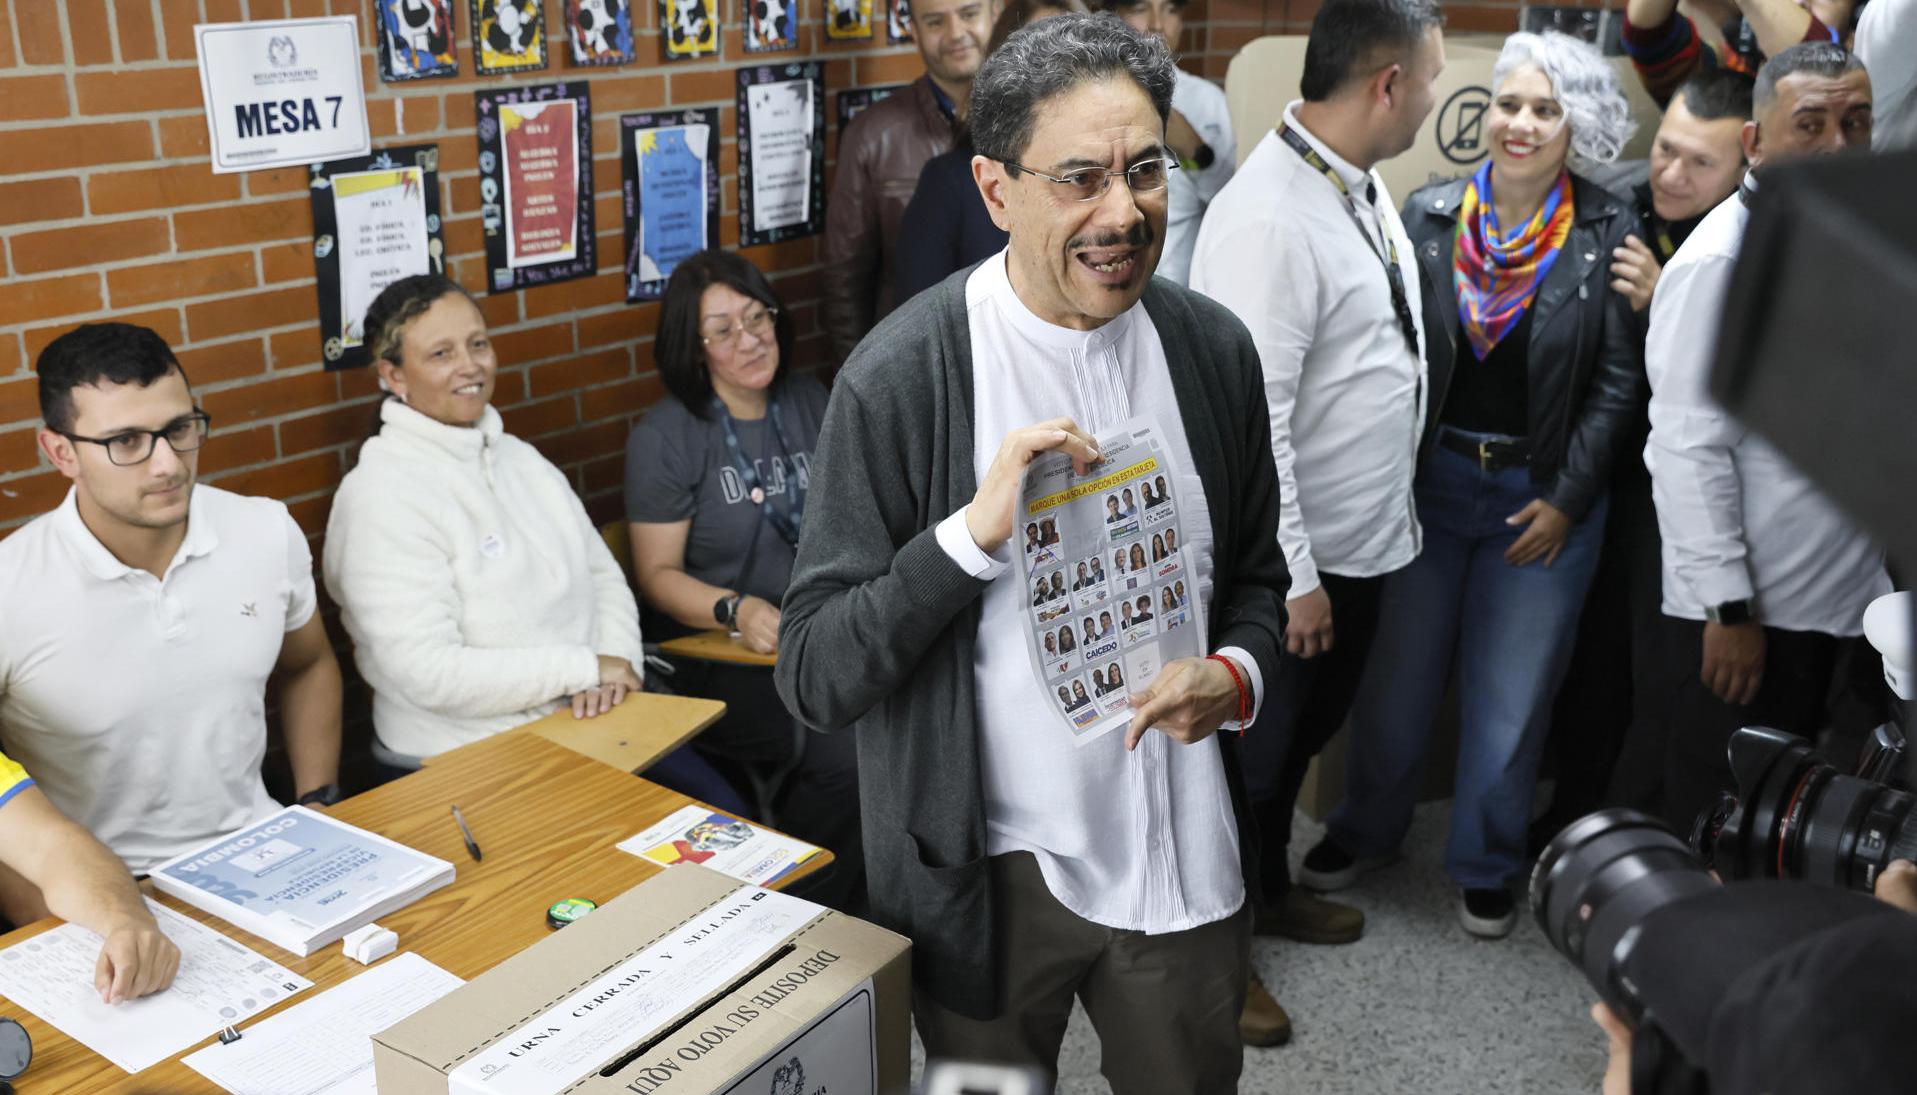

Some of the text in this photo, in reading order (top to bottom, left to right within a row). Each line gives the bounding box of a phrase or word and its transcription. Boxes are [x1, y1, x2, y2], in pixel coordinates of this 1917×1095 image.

[235, 96, 342, 139] MESA 7
[1030, 497, 1056, 513] MARQUE
[1057, 493, 1070, 504] UNA
[1071, 487, 1087, 499] SOLA
[1112, 477, 1121, 485] EN
[1121, 470, 1134, 481] ESTA
[1134, 460, 1157, 476] TARJETA
[1085, 641, 1118, 660] CAICEDO
[180, 818, 298, 874] COLOMBIA
[282, 852, 378, 901] PRESIDENCIA
[508, 1026, 561, 1058] URNA
[572, 968, 652, 1018] CERRADA
[659, 951, 674, 961] Y
[684, 904, 751, 946] SELLADA
[751, 950, 840, 1010] DEPOSITE
[726, 1005, 760, 1028] SU
[677, 1025, 737, 1062] VOTO
